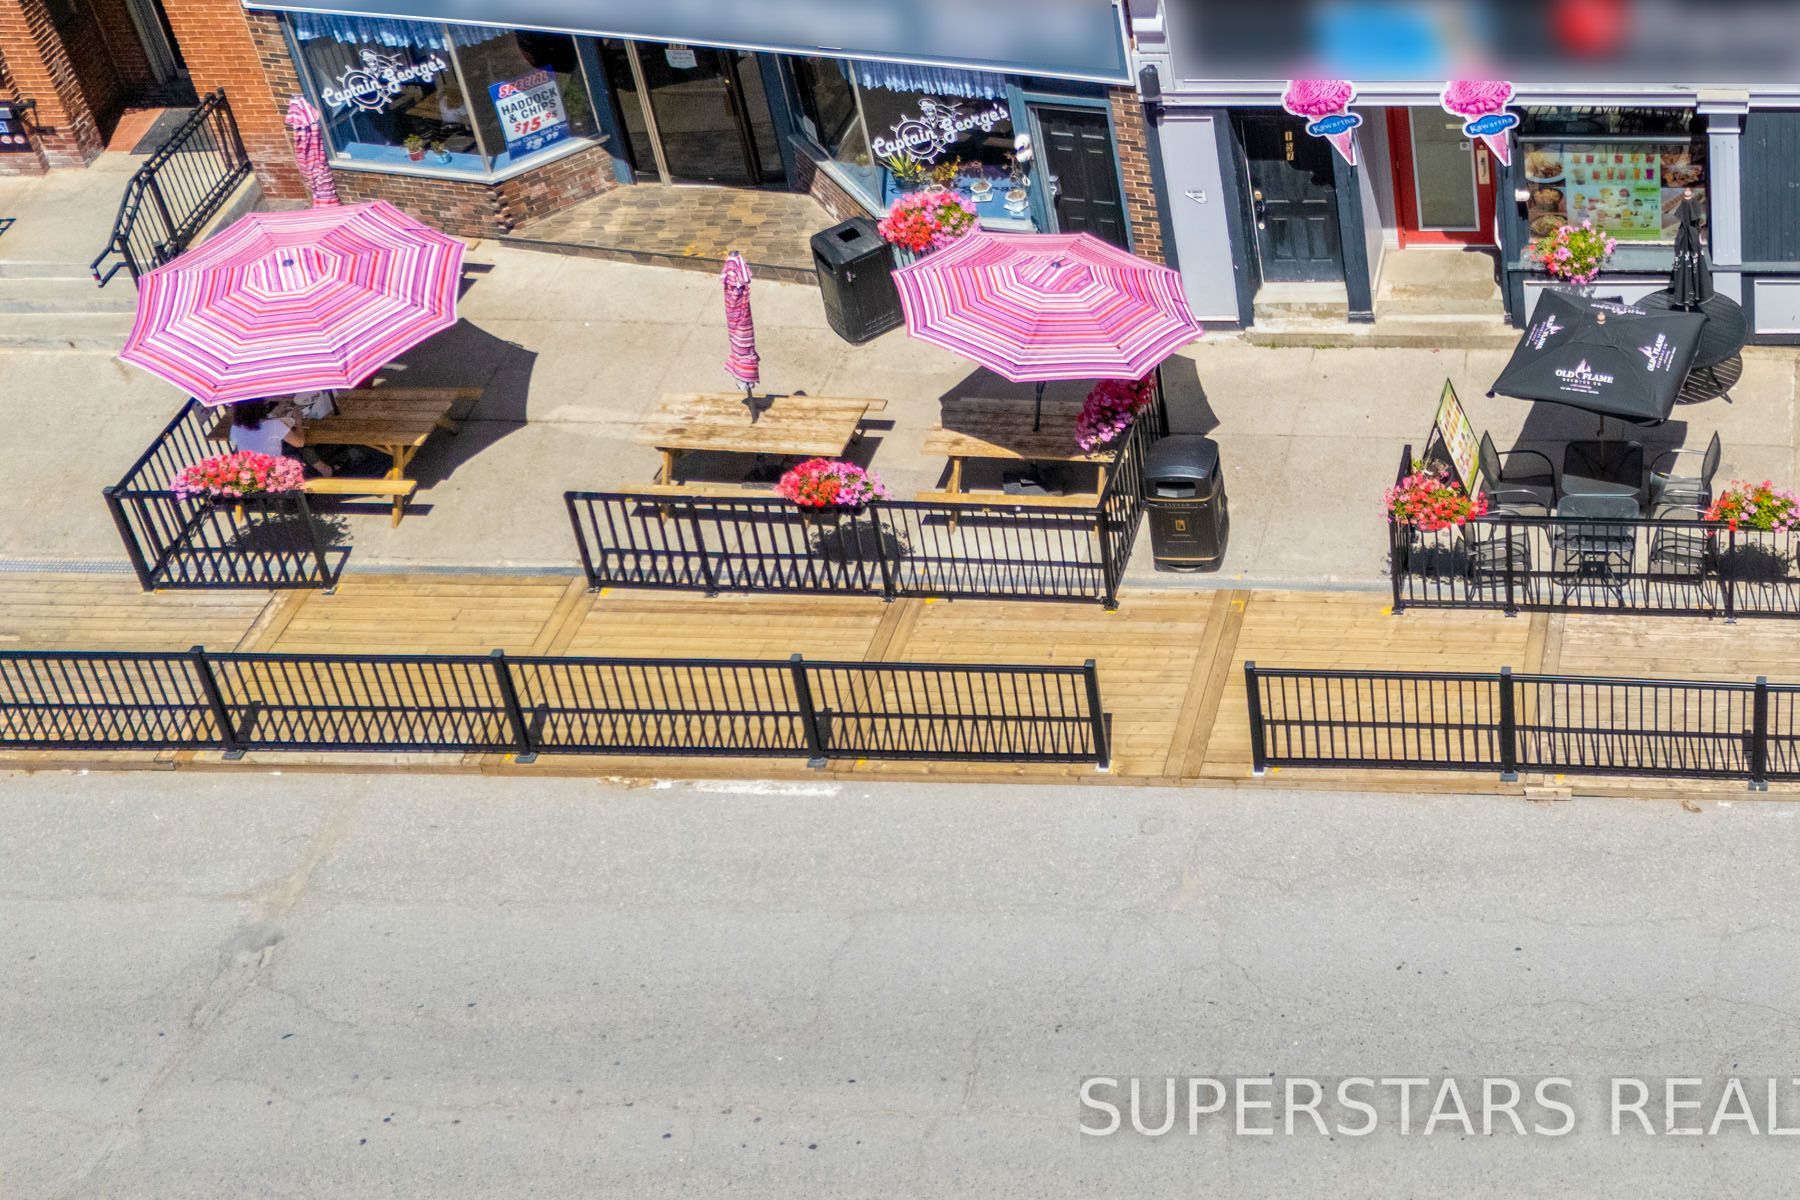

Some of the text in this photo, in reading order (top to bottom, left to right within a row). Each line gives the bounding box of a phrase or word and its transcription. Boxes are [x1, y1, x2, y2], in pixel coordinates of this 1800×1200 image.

[322, 53, 448, 107] Captain George's
[498, 70, 549, 99] SPECIAL
[501, 87, 558, 116] HADDOCK
[508, 99, 557, 124] & CHIPS
[872, 103, 1010, 158] Captain George's
[1311, 115, 1356, 134] Kawartha
[1469, 117, 1514, 133] Kawartha
[1555, 369, 1614, 384] OLD FLAME
